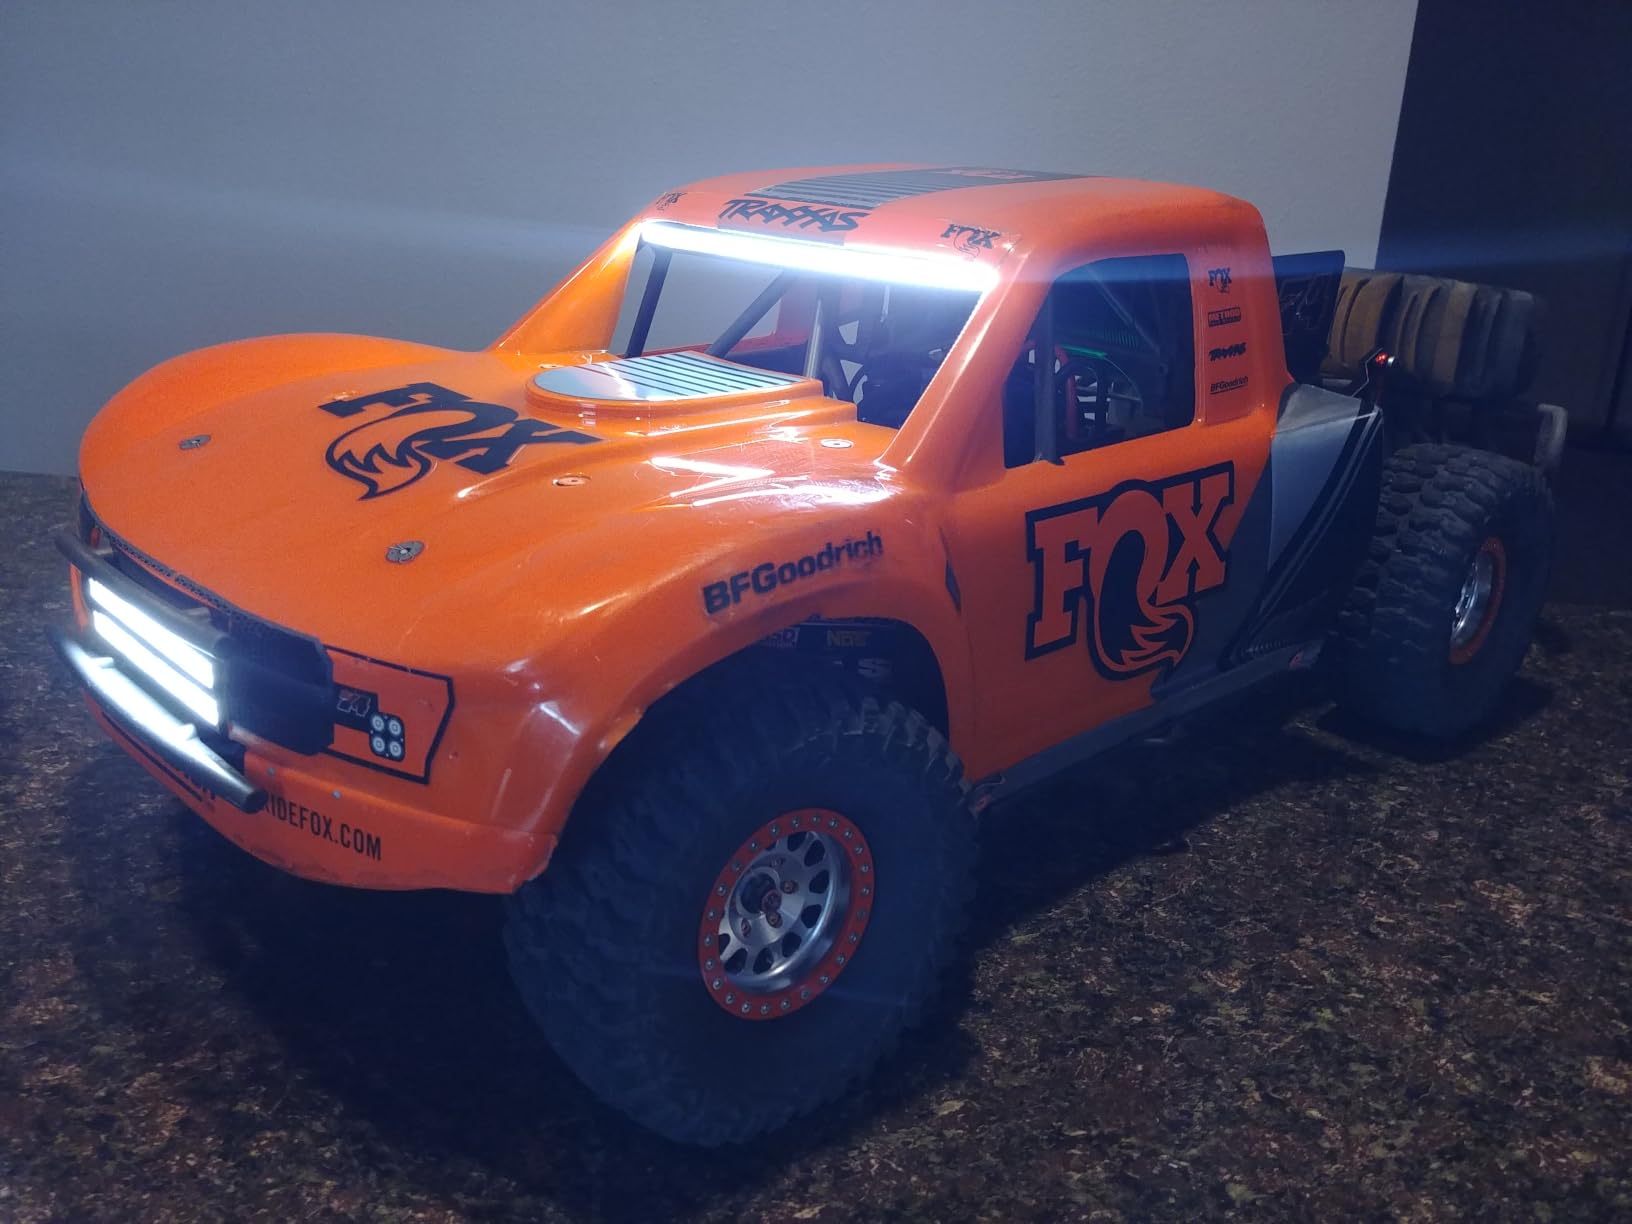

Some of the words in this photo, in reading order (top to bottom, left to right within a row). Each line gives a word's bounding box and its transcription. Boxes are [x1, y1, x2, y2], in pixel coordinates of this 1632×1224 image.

[718, 199, 869, 232] TRAXXAS
[941, 224, 1001, 258] FOX
[1208, 267, 1232, 293] FOX
[1210, 376, 1248, 393] BFGoodrich
[318, 381, 603, 500] FOX
[703, 530, 883, 615] BFGoodrich
[1025, 460, 1234, 681] FOX
